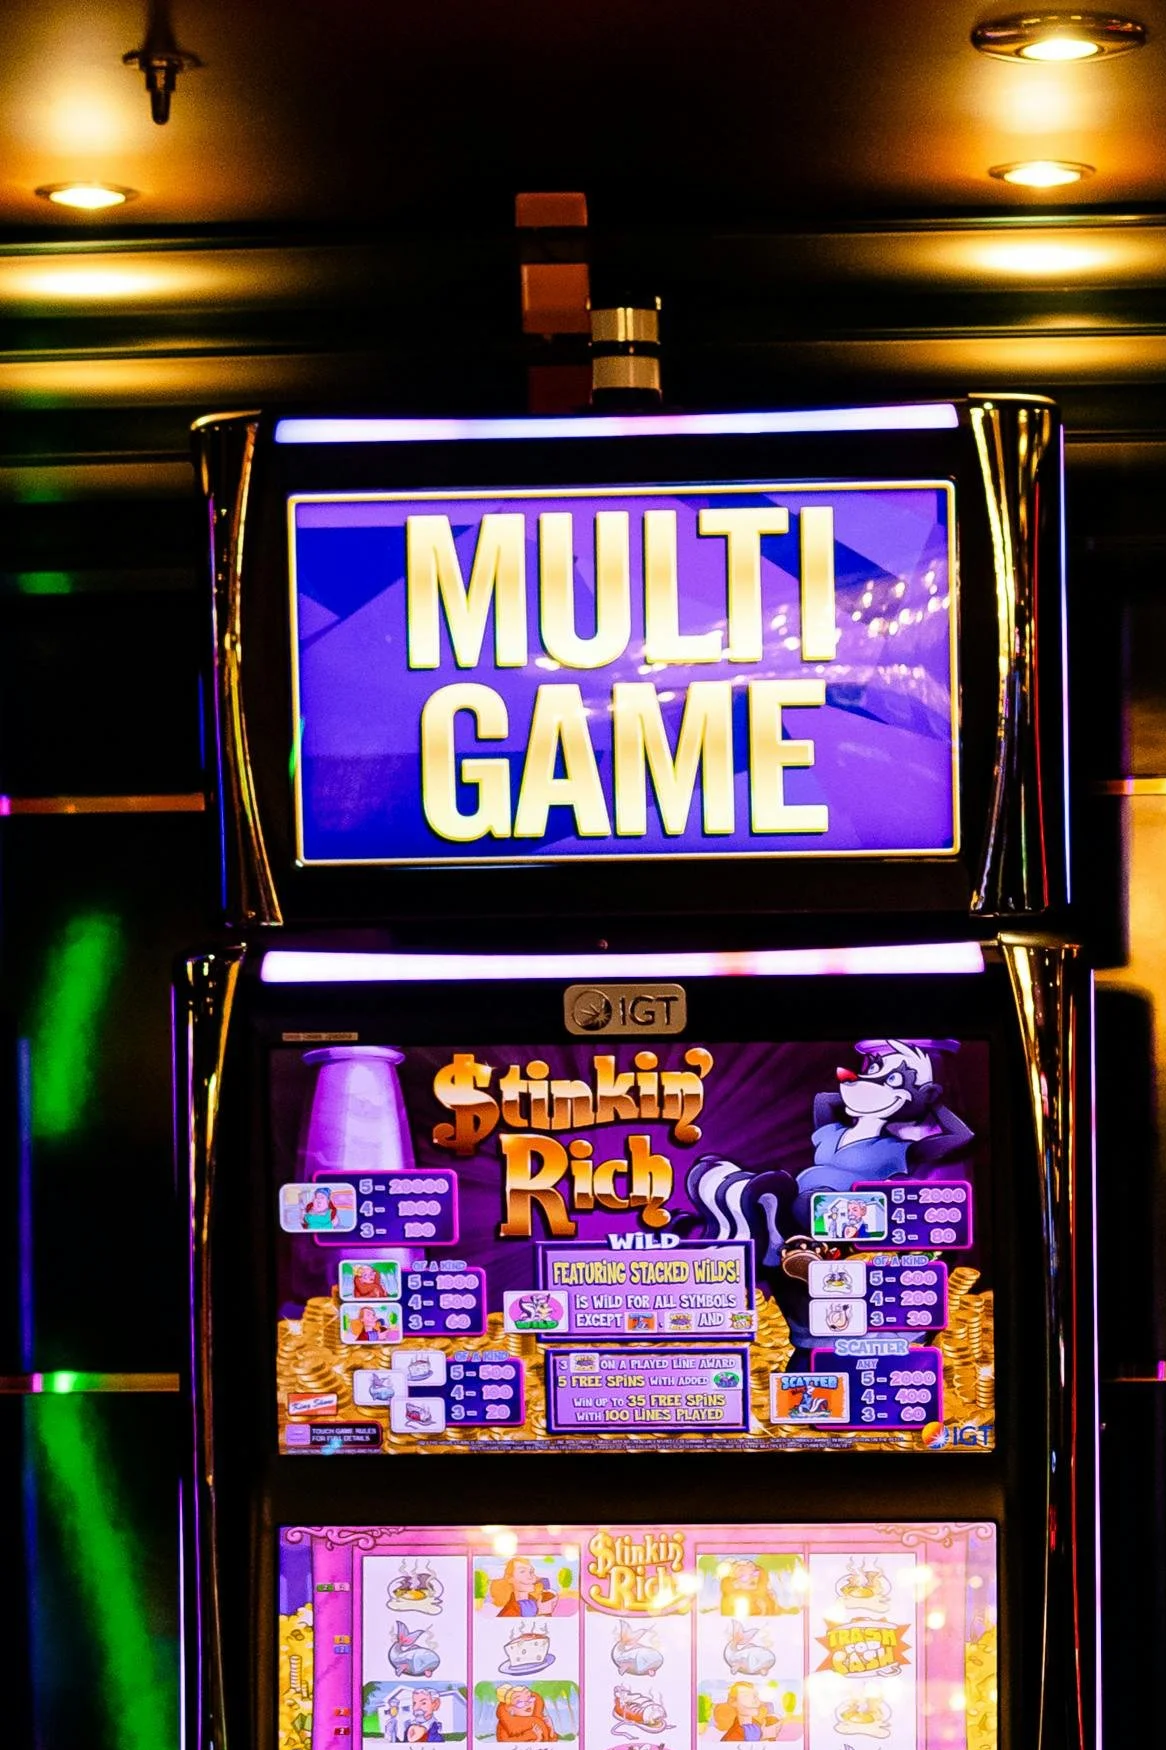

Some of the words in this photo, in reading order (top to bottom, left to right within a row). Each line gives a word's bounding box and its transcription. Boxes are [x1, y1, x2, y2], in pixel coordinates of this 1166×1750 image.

[406, 506, 837, 669] MULTI
[421, 678, 830, 842] GAME
[619, 995, 679, 1026] IGT
[499, 1133, 673, 1236] Rich
[930, 1228, 956, 1243] 80
[873, 1256, 888, 1266] OF
[890, 1256, 900, 1266] A
[630, 1260, 689, 1284] STACKED
[627, 1295, 649, 1309] FOR
[654, 1294, 676, 1308] ALL
[680, 1294, 736, 1308] SYMBOLS
[900, 1291, 937, 1306] 200
[576, 1313, 622, 1327] EXCEPT
[698, 1313, 724, 1328] AND
[906, 1310, 932, 1326] 30
[835, 1339, 909, 1356] SCATTER
[559, 1361, 567, 1371] 3
[601, 1361, 615, 1370] ON
[619, 1361, 627, 1370] A
[630, 1360, 668, 1370] PLAYED
[699, 1359, 736, 1369] AWARD
[856, 1359, 878, 1369] ANY
[558, 1376, 567, 1388] 5
[571, 1376, 602, 1387] FREE
[677, 1376, 709, 1386] ADDED
[781, 1376, 838, 1390] SCATTER
[890, 1371, 936, 1386] 2000
[595, 1398, 608, 1407] UP
[612, 1398, 624, 1407] TO
[627, 1395, 646, 1407] 35
[651, 1395, 681, 1407] FREE
[895, 1389, 931, 1403] 400
[486, 1404, 510, 1419] 20
[605, 1409, 629, 1421] 100
[676, 1408, 724, 1421] PLAYED
[901, 1406, 926, 1421] 60
[953, 1426, 993, 1445] IGT
[828, 1627, 898, 1647] TRASH
[831, 1646, 896, 1674] CASH
